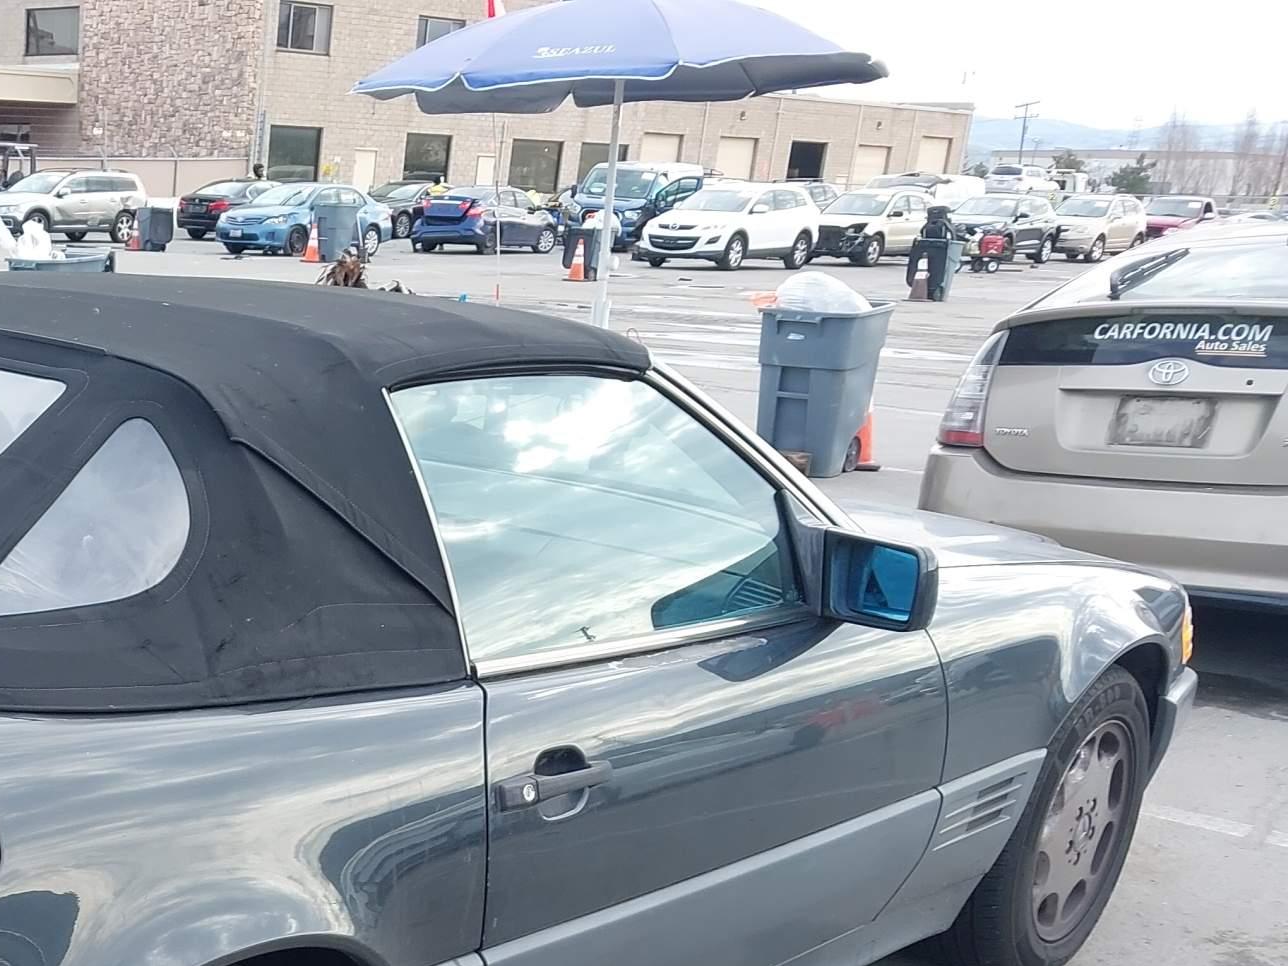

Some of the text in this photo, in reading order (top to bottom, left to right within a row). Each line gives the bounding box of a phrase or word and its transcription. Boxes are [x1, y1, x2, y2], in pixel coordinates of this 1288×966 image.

[547, 45, 617, 56] SEAZUL
[1094, 322, 1274, 342] CARFORNIA.COM
[1195, 340, 1267, 352] Auto Sales
[995, 427, 1029, 437] TOYOTA
